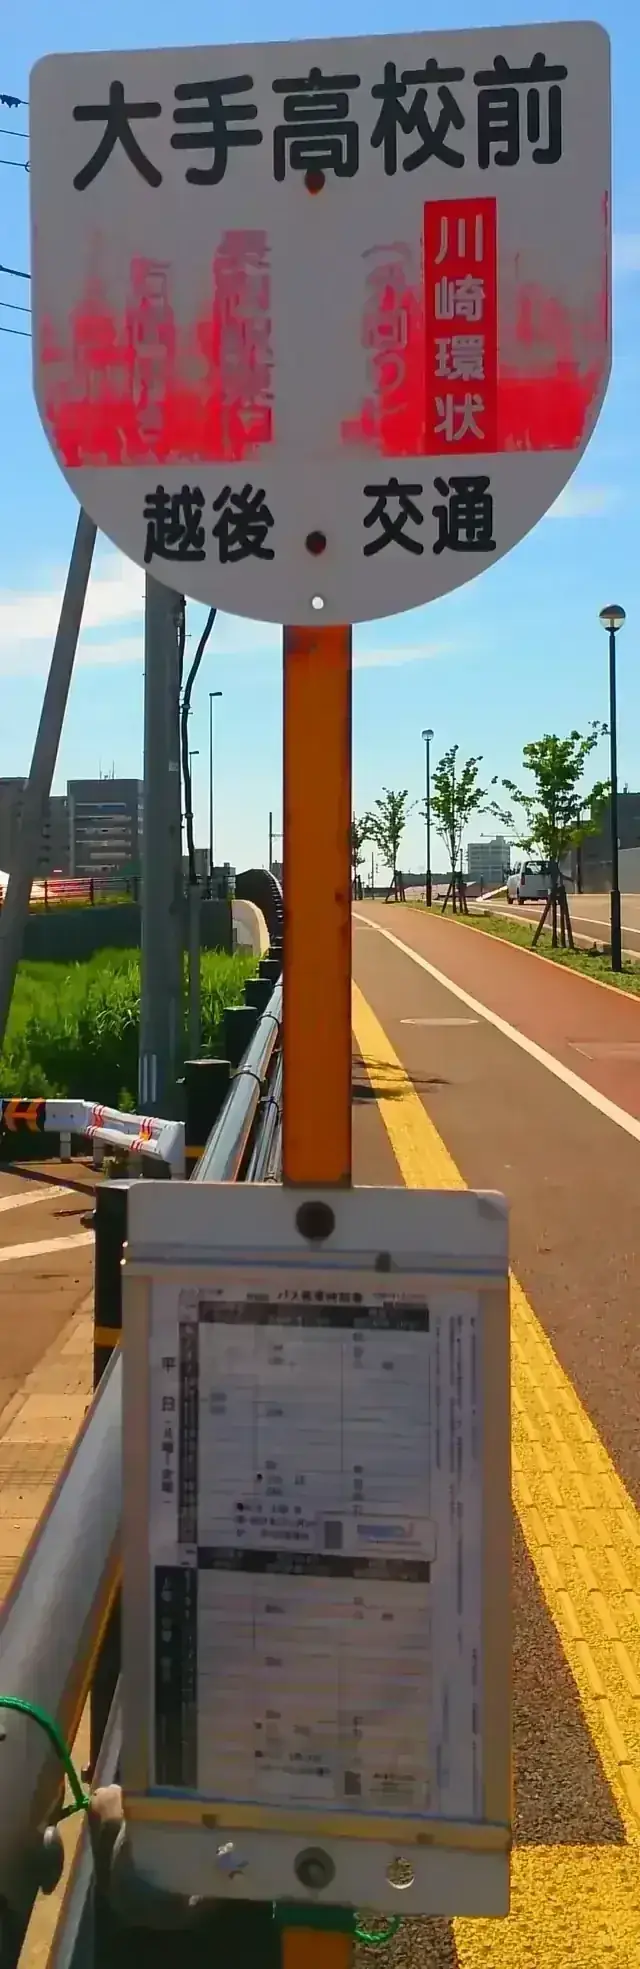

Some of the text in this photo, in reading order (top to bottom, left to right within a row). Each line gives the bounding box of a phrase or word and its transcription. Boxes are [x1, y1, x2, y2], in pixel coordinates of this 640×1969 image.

[72, 52, 569, 192] 大手高校前
[433, 213, 486, 443] 川崎環状
[143, 476, 496, 564] 越後 交通
